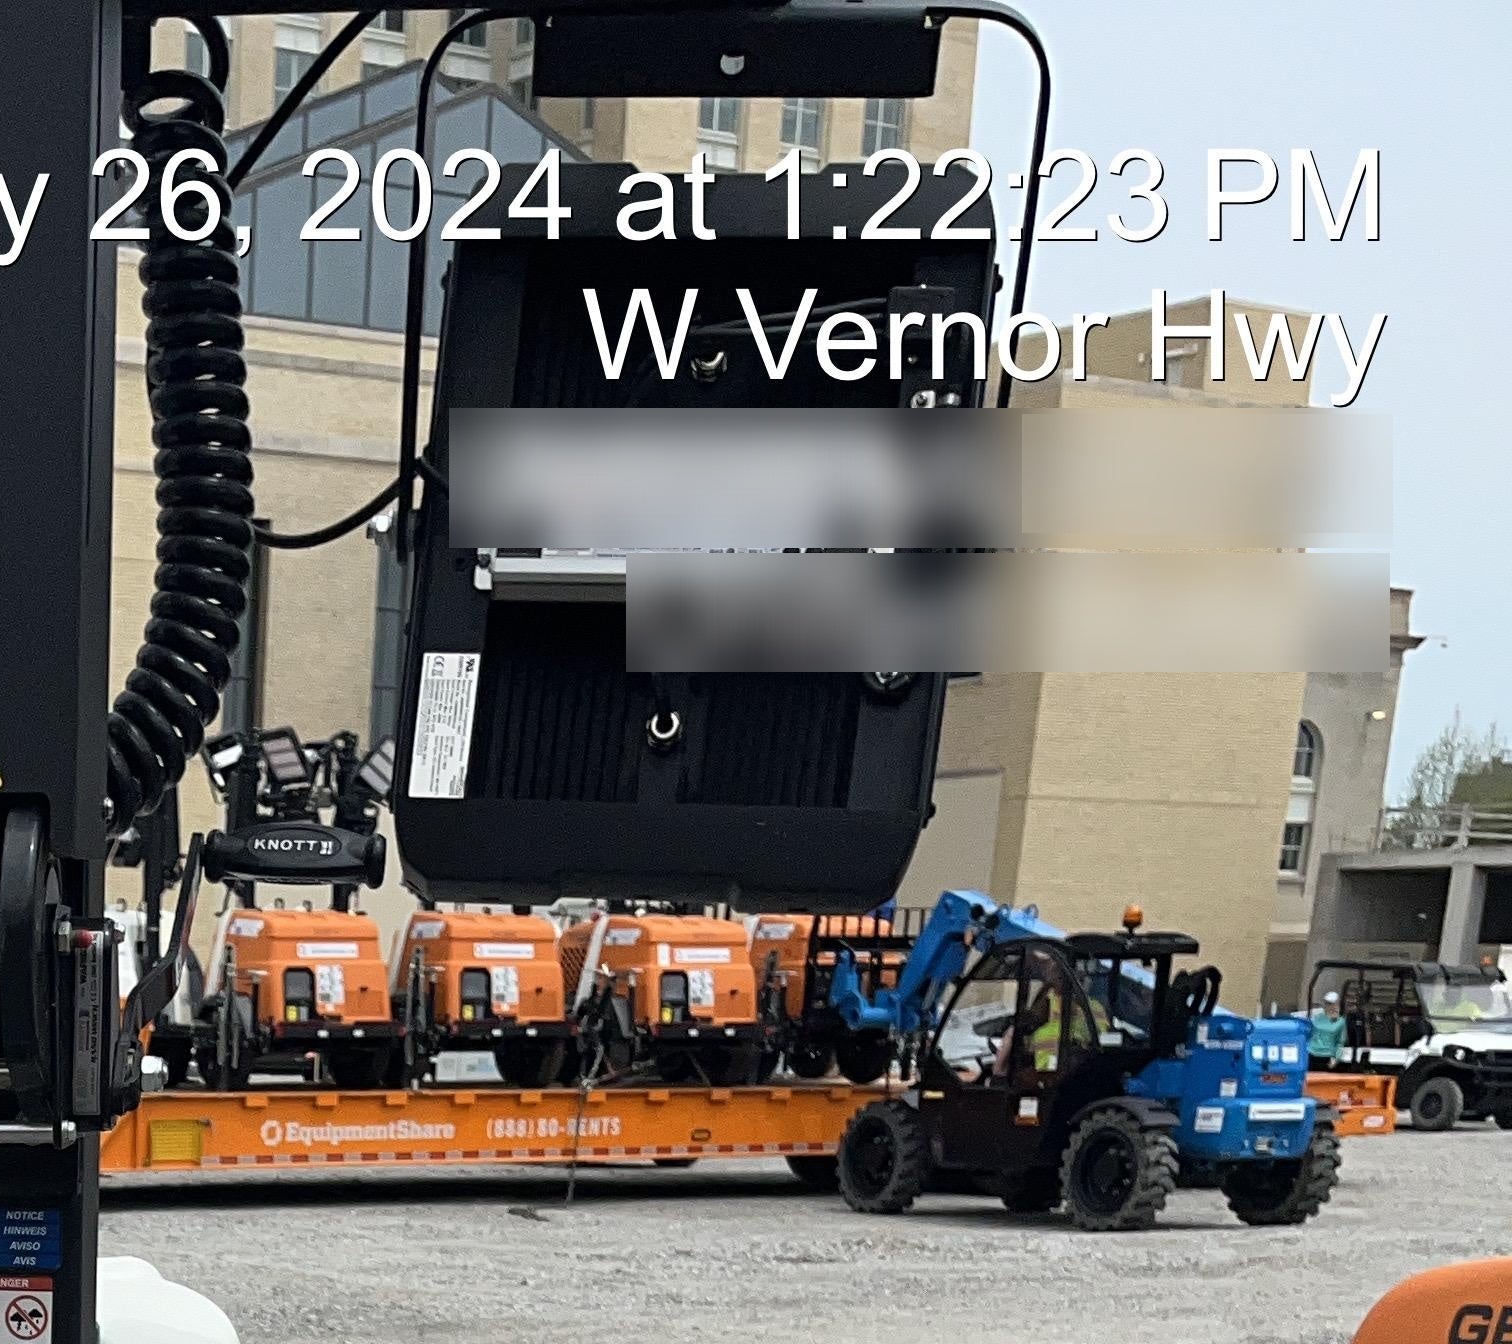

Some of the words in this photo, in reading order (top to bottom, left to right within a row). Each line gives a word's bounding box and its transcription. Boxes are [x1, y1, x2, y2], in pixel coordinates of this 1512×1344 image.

[253, 838, 318, 851] KNOTT
[286, 1119, 456, 1145] EquipmentShare
[6, 1210, 45, 1221] NOTICE
[3, 1225, 47, 1236] HINWEIS
[9, 1241, 41, 1251] AVISO
[13, 1256, 37, 1266] AVIS
